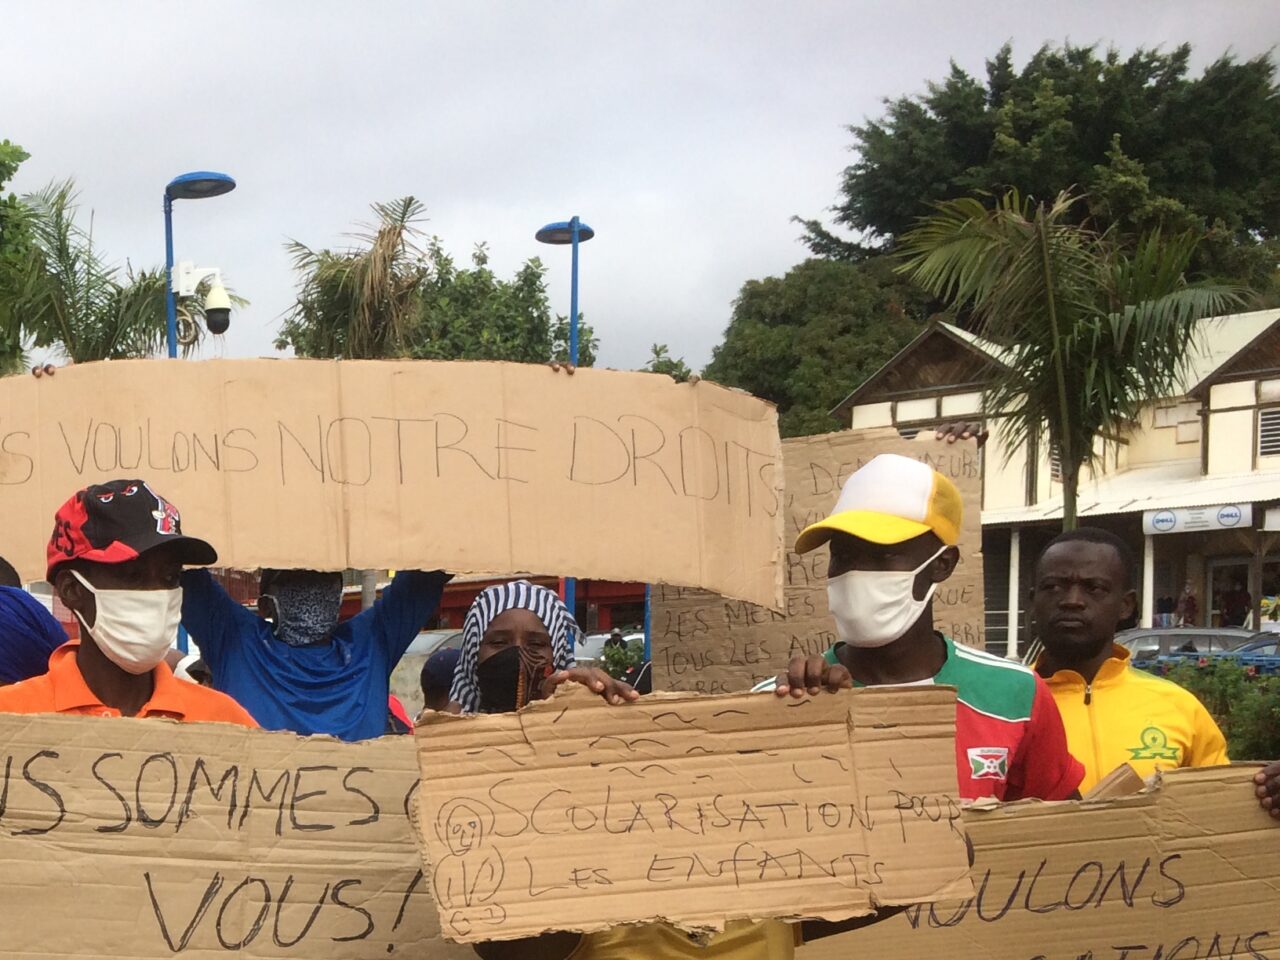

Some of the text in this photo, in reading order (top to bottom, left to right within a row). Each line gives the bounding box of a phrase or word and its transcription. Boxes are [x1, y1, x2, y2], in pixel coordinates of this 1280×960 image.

[58, 417, 259, 475] VOULONS
[277, 412, 539, 487] NOTRE
[566, 414, 781, 518] DROITS
[659, 645, 715, 678] TOUS
[90, 749, 382, 836] SOMMES
[486, 777, 875, 840] SCOLARISATION
[887, 789, 967, 844] POUR
[523, 841, 885, 898] LES ENFANTS
[904, 840, 1188, 931] ULONS
[144, 870, 423, 954] VOUS!
